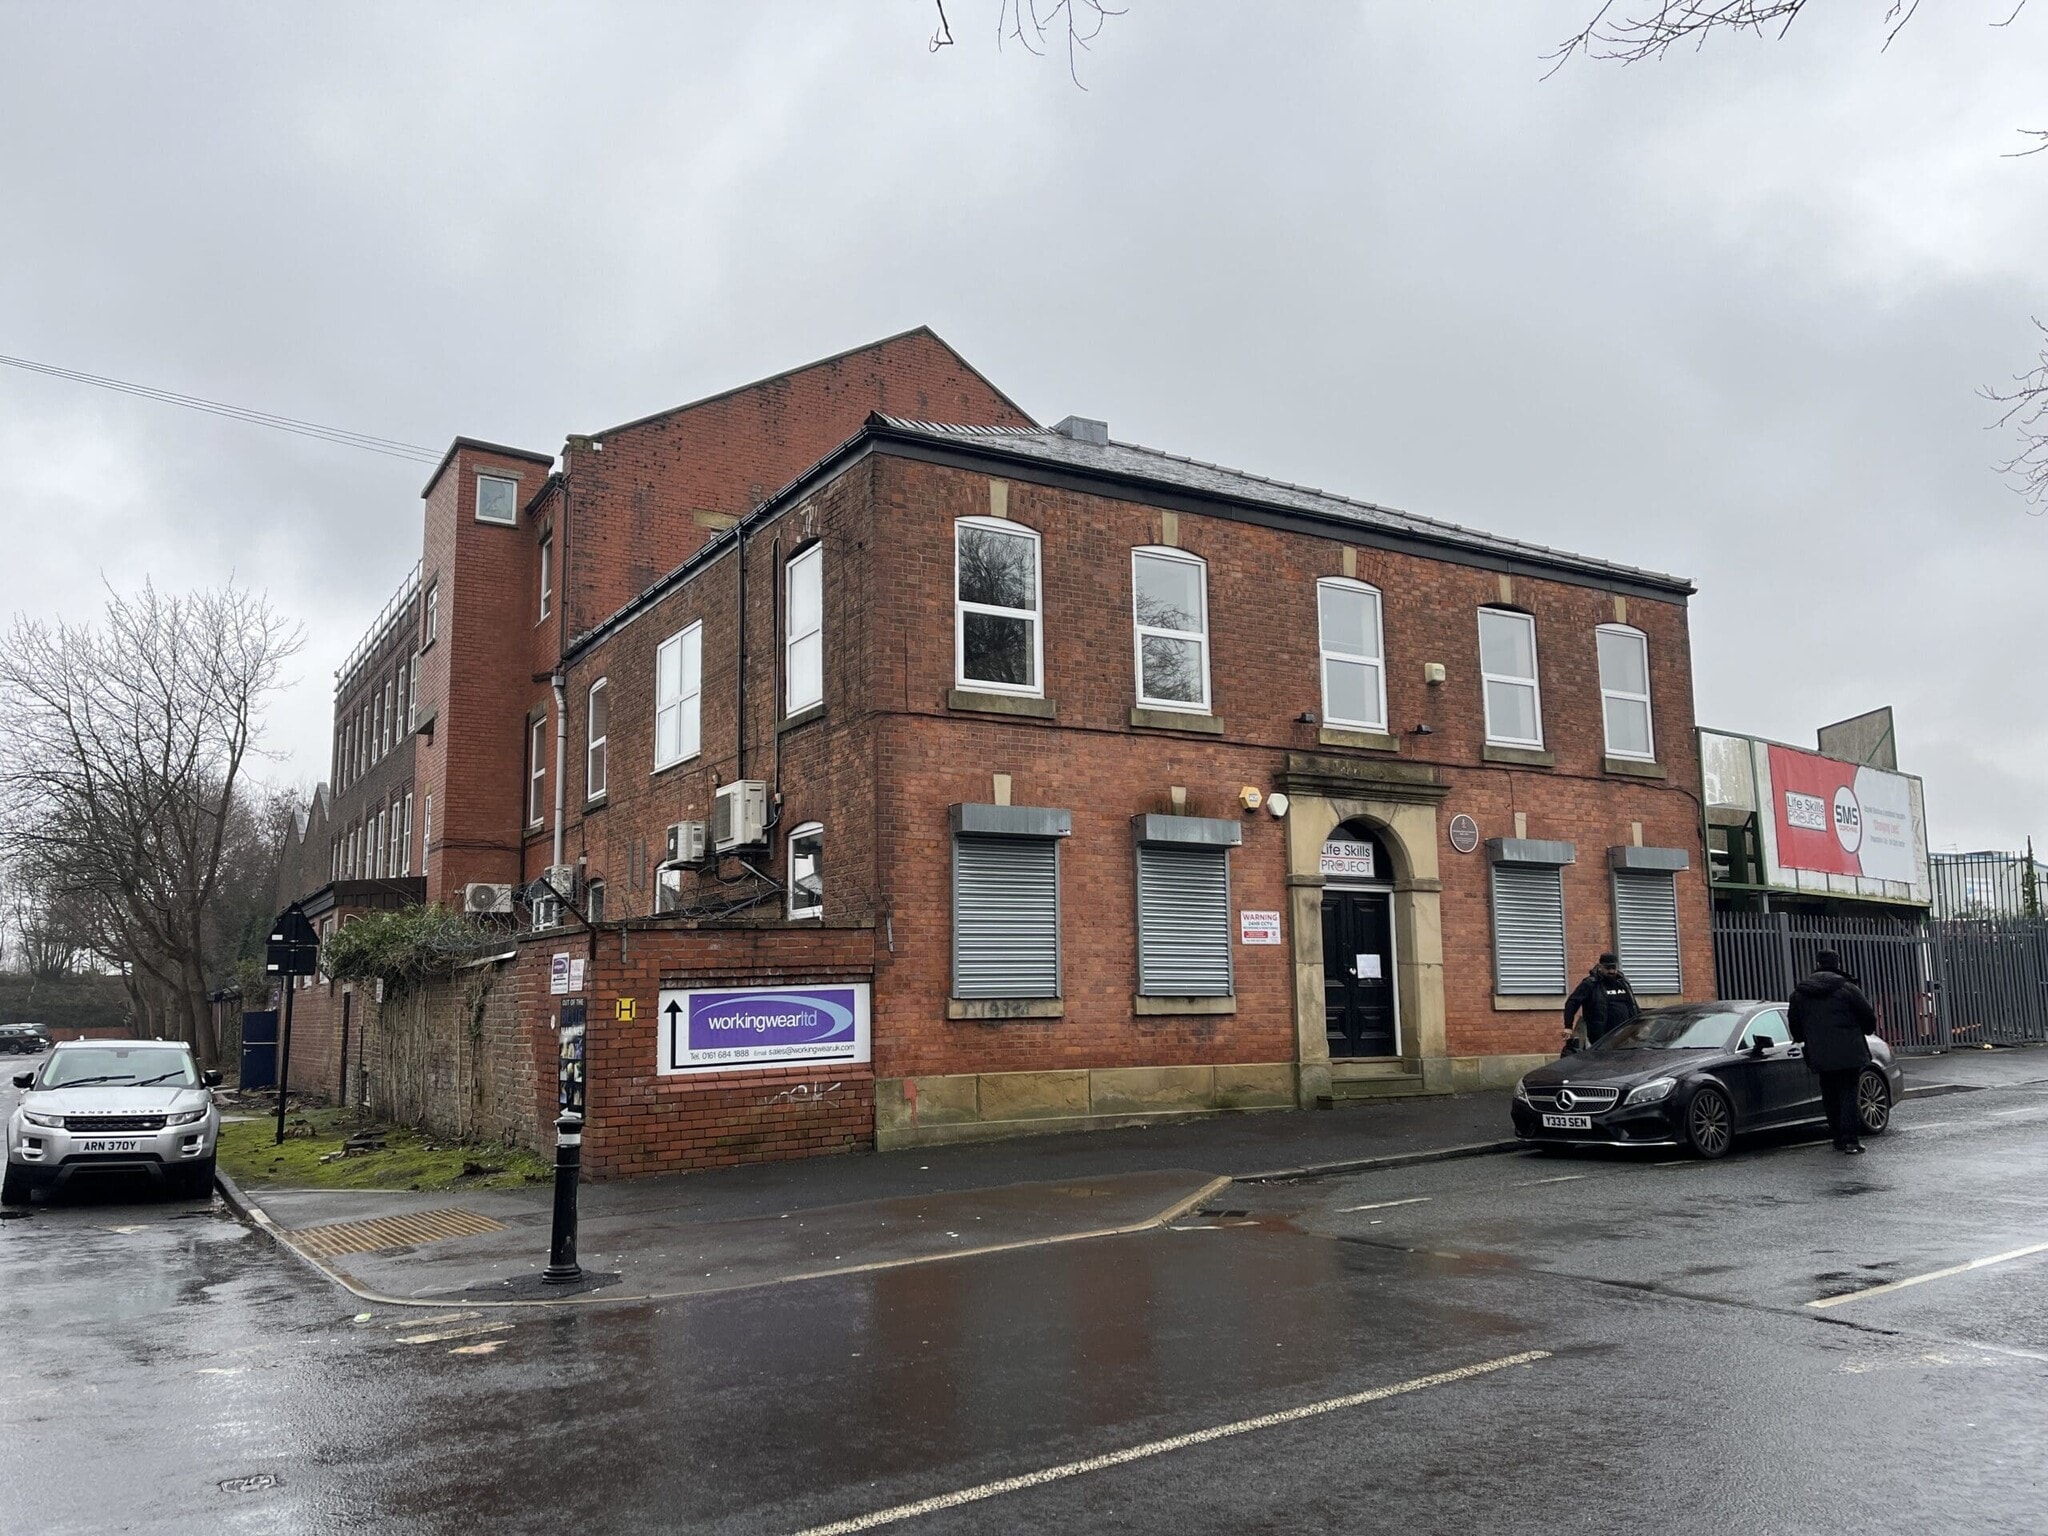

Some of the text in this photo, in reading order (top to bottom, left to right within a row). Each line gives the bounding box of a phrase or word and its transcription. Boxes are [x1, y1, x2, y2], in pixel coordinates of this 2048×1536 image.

[1787, 796, 1824, 813] Life Skills
[1788, 809, 1825, 826] PROJECT
[1836, 804, 1859, 826] SMS
[1344, 844, 1371, 858] Skills
[1321, 859, 1371, 873] PROJECT
[1242, 913, 1278, 921] WARNING
[619, 1000, 633, 1018] H
[702, 1052, 717, 1060] 0161
[717, 1051, 731, 1059] 684
[734, 1049, 749, 1058] 1888
[1546, 1116, 1587, 1128] Y333 SEN
[83, 1141, 137, 1151] ARN 370Y
